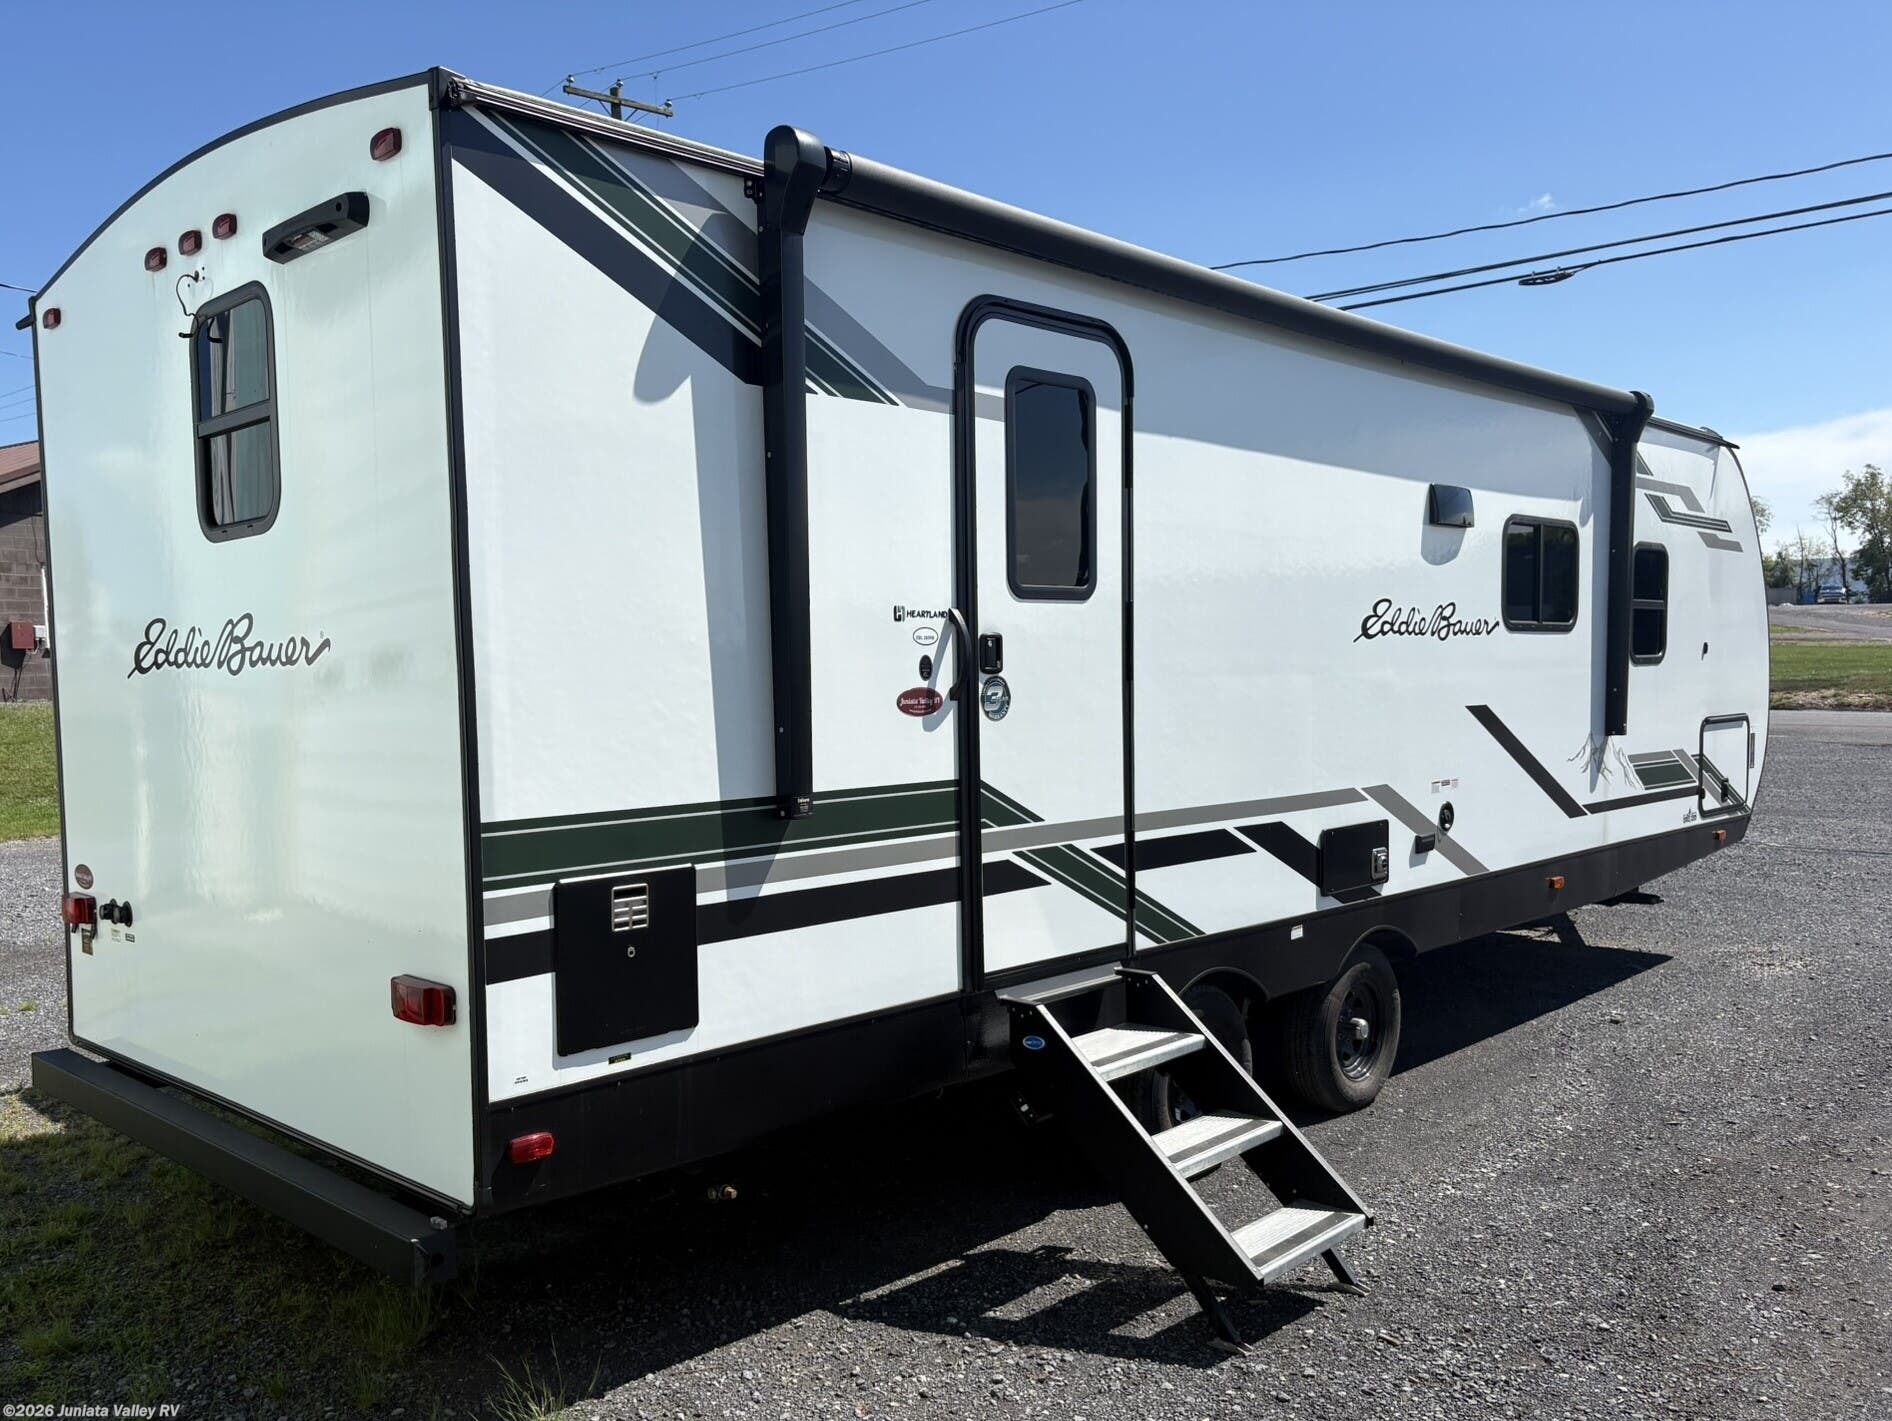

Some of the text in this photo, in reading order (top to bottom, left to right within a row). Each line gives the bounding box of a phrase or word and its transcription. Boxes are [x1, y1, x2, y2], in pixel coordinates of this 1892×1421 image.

[906, 609, 948, 619] HEARTLAND
[1353, 598, 1499, 643] Eddie Bauer
[127, 612, 331, 679] Eddie Bauer
